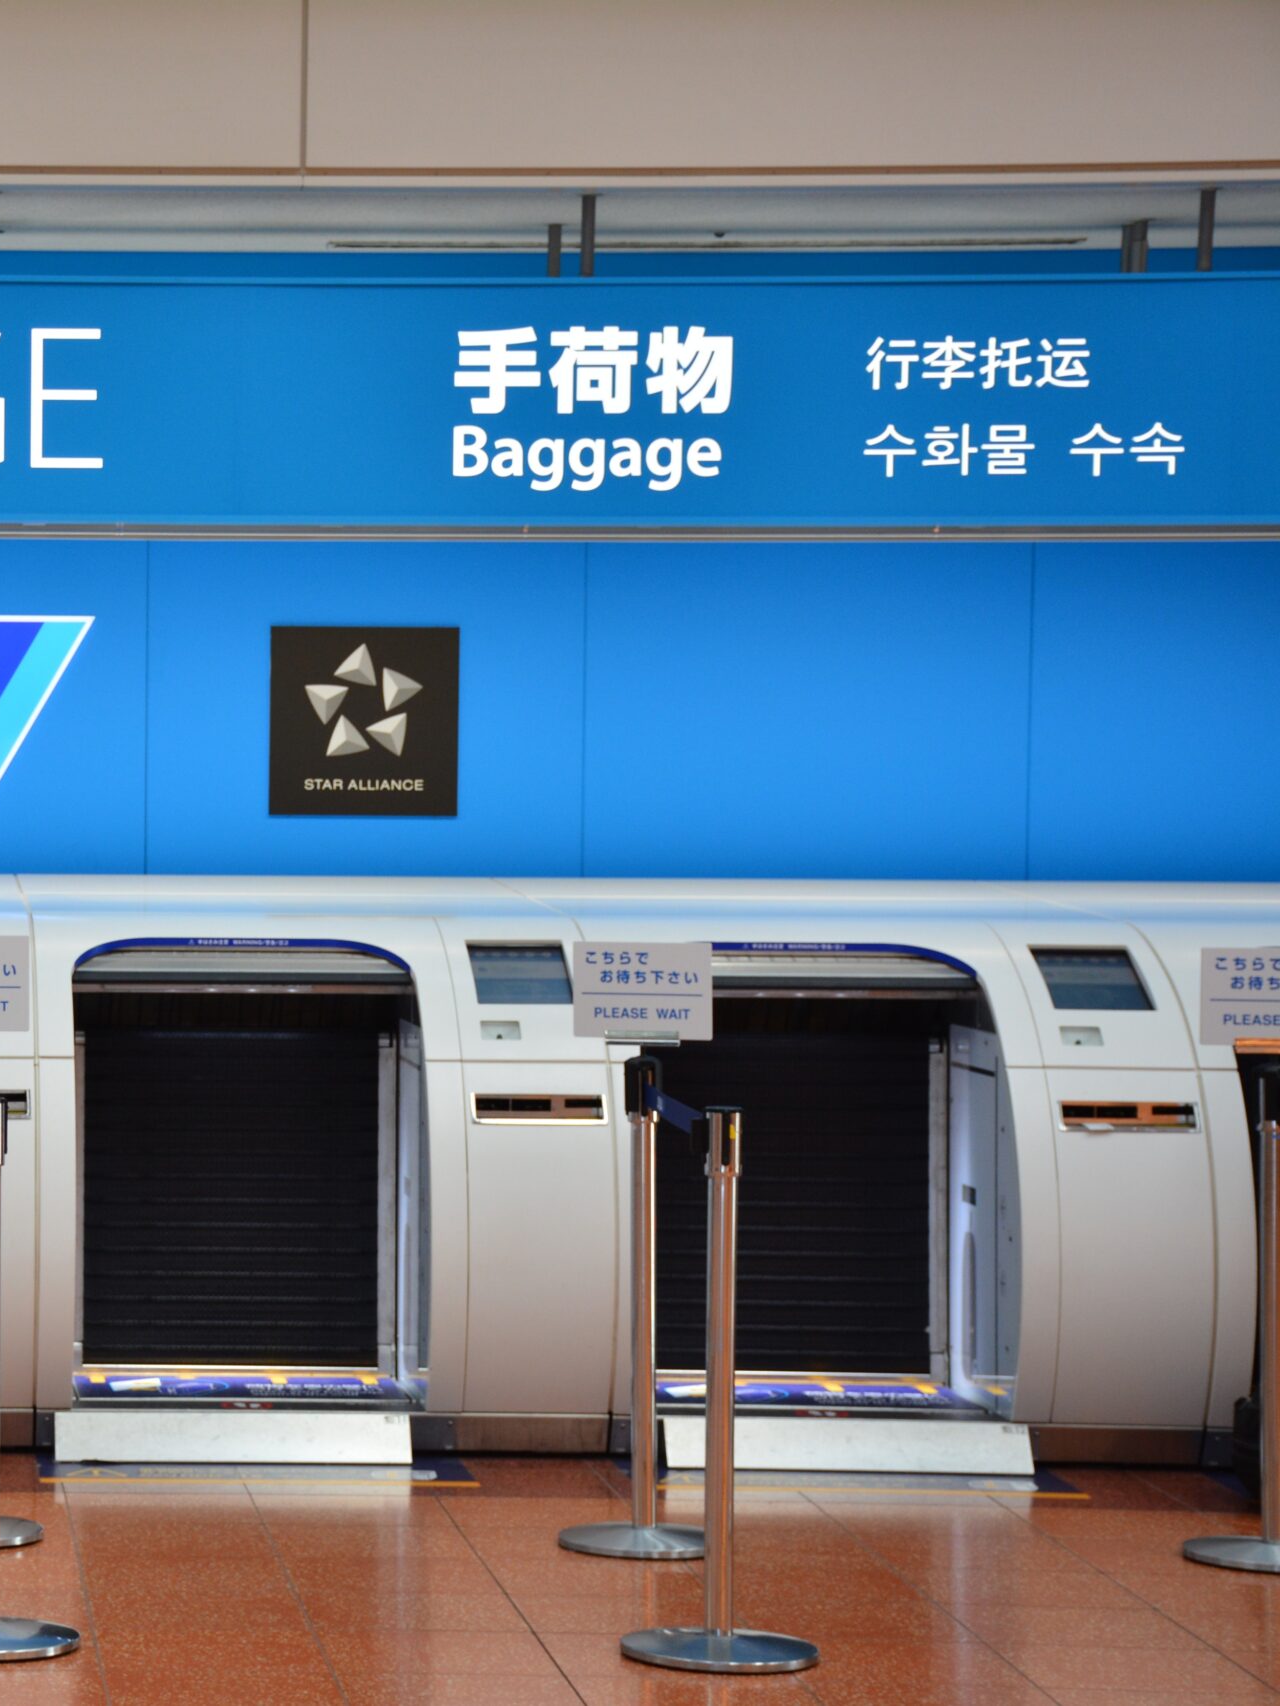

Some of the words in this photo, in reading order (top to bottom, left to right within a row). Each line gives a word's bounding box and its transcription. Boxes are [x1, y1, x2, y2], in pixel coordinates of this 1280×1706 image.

[865, 335, 1090, 390] 行李托运
[453, 325, 734, 415] 手荷物
[863, 423, 1035, 478] 수화물
[1069, 422, 1185, 477] 수속
[452, 424, 722, 492] Baggage
[304, 778, 344, 791] STAR
[347, 778, 424, 792] ALLIANCE
[585, 951, 649, 965] こちらで
[600, 970, 699, 984] お待ち下さい
[593, 1007, 648, 1019] PLEASE
[656, 1008, 691, 1020] WAIT
[1222, 1013, 1280, 1026] PLEASE
